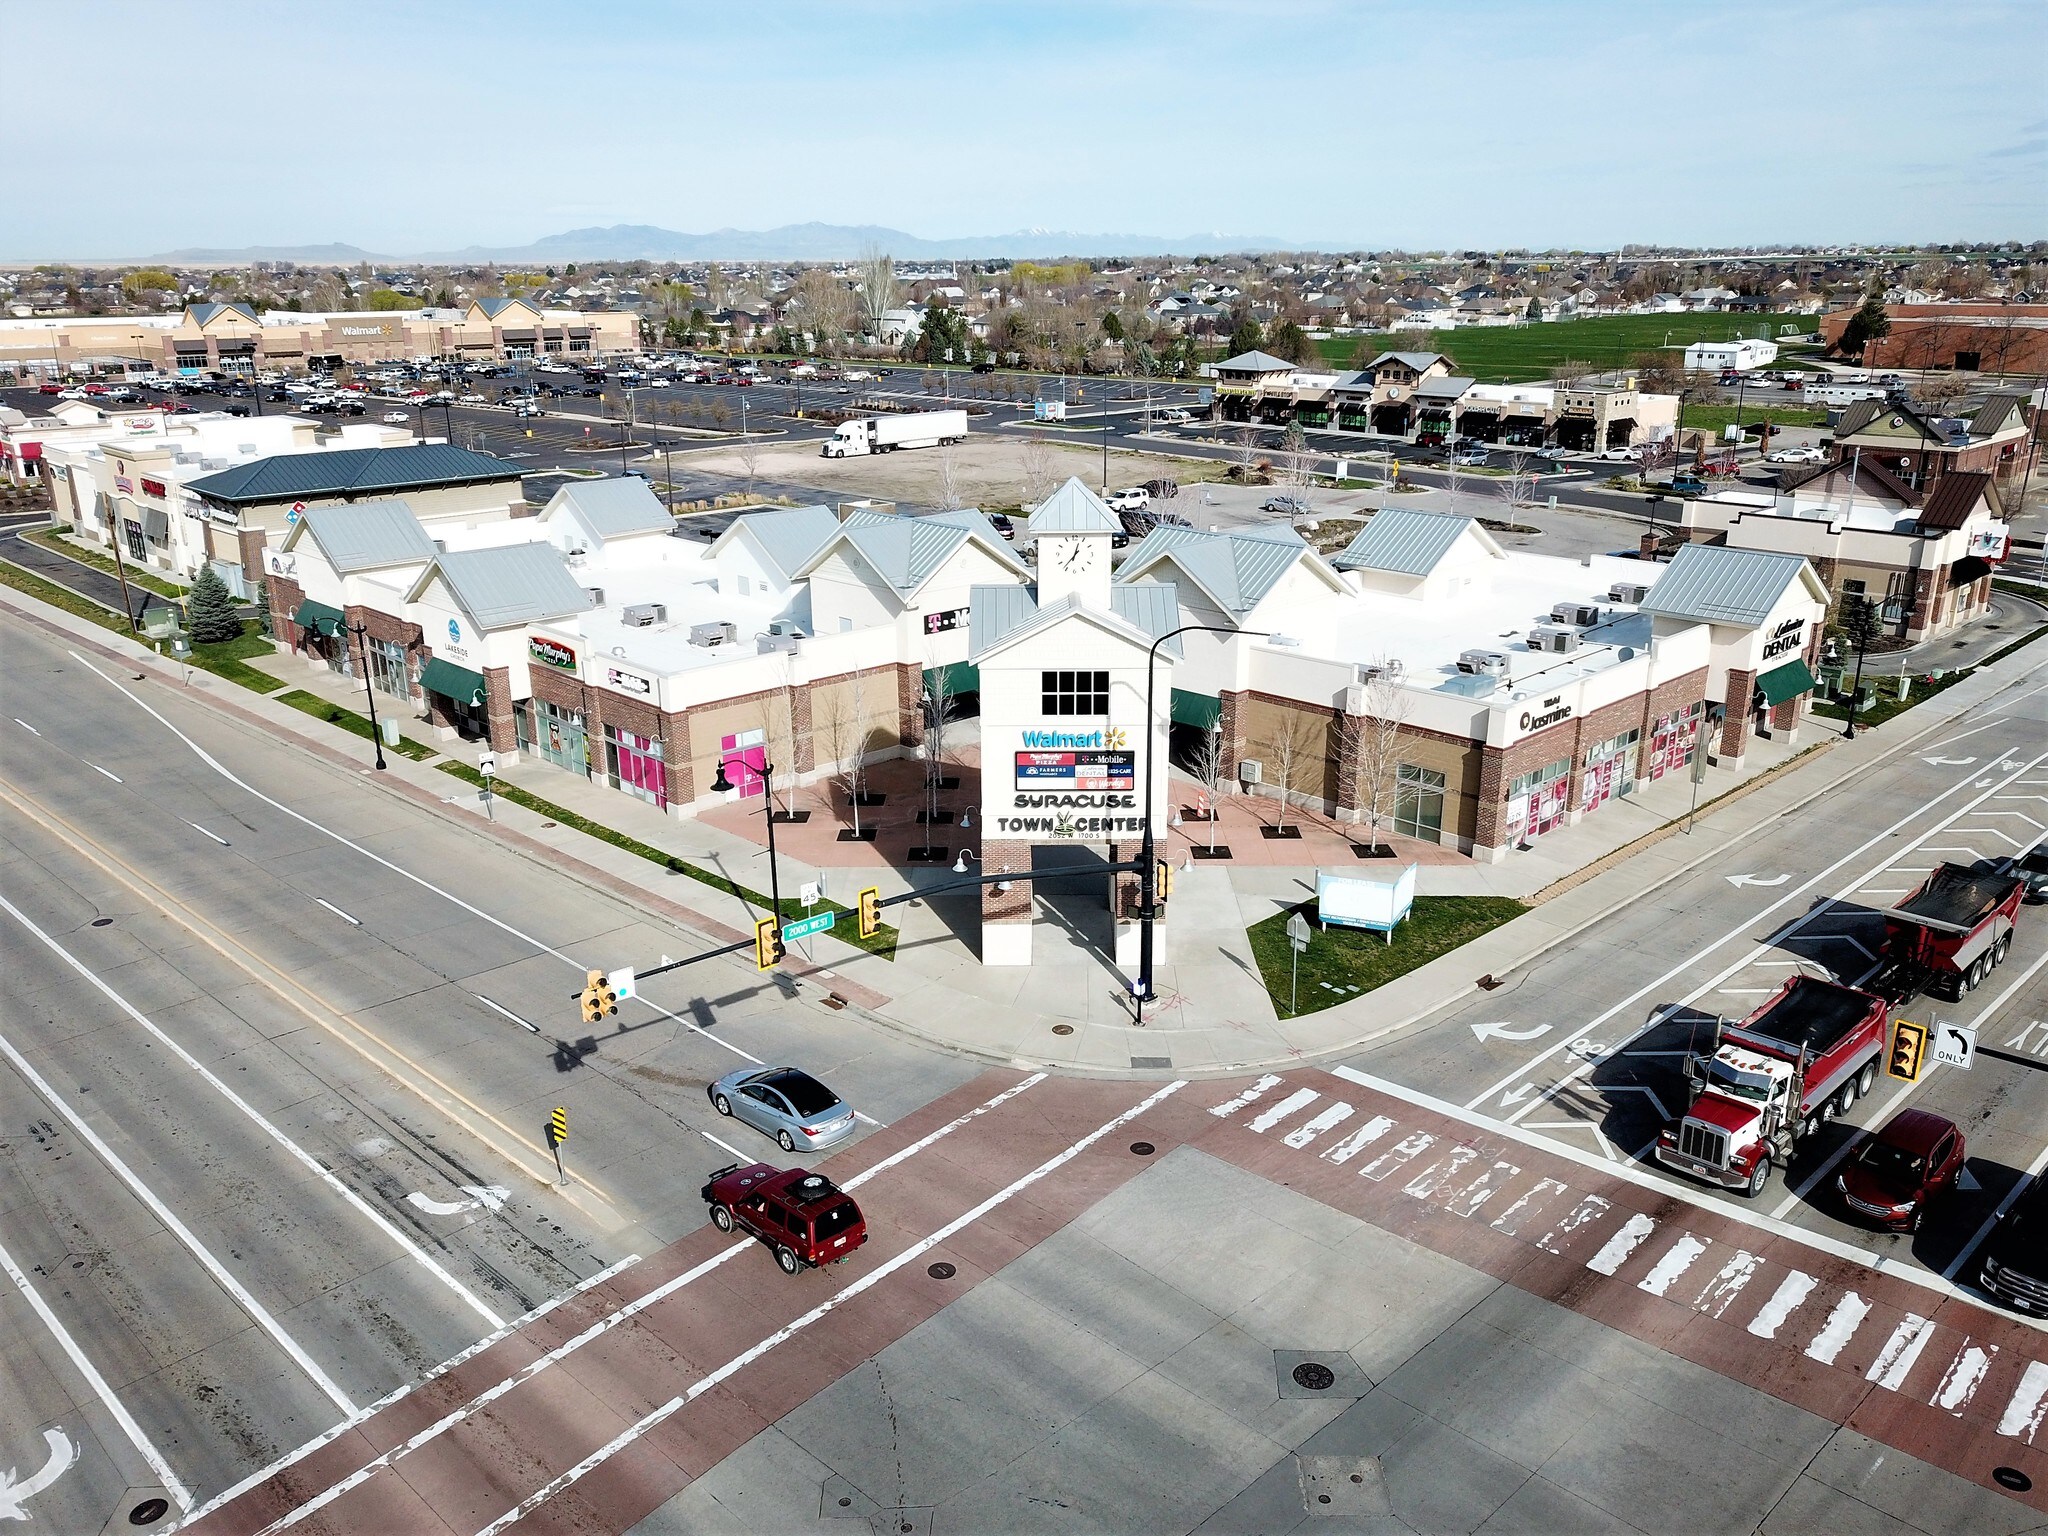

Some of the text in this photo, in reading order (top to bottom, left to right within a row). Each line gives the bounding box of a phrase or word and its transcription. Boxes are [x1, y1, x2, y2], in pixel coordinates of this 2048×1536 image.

[341, 325, 382, 336] Walmart
[444, 643, 469, 657] LAKESIDE
[528, 638, 571, 665] Papa Murphy's
[1762, 631, 1802, 661] DENTAL
[1022, 730, 1103, 748] Walmart
[1014, 794, 1137, 809] SYRACUSE
[998, 817, 1054, 832] TOWN
[803, 892, 817, 902] 45
[788, 917, 829, 937] 2000 WEST
[1938, 1050, 1965, 1064] ONLY
